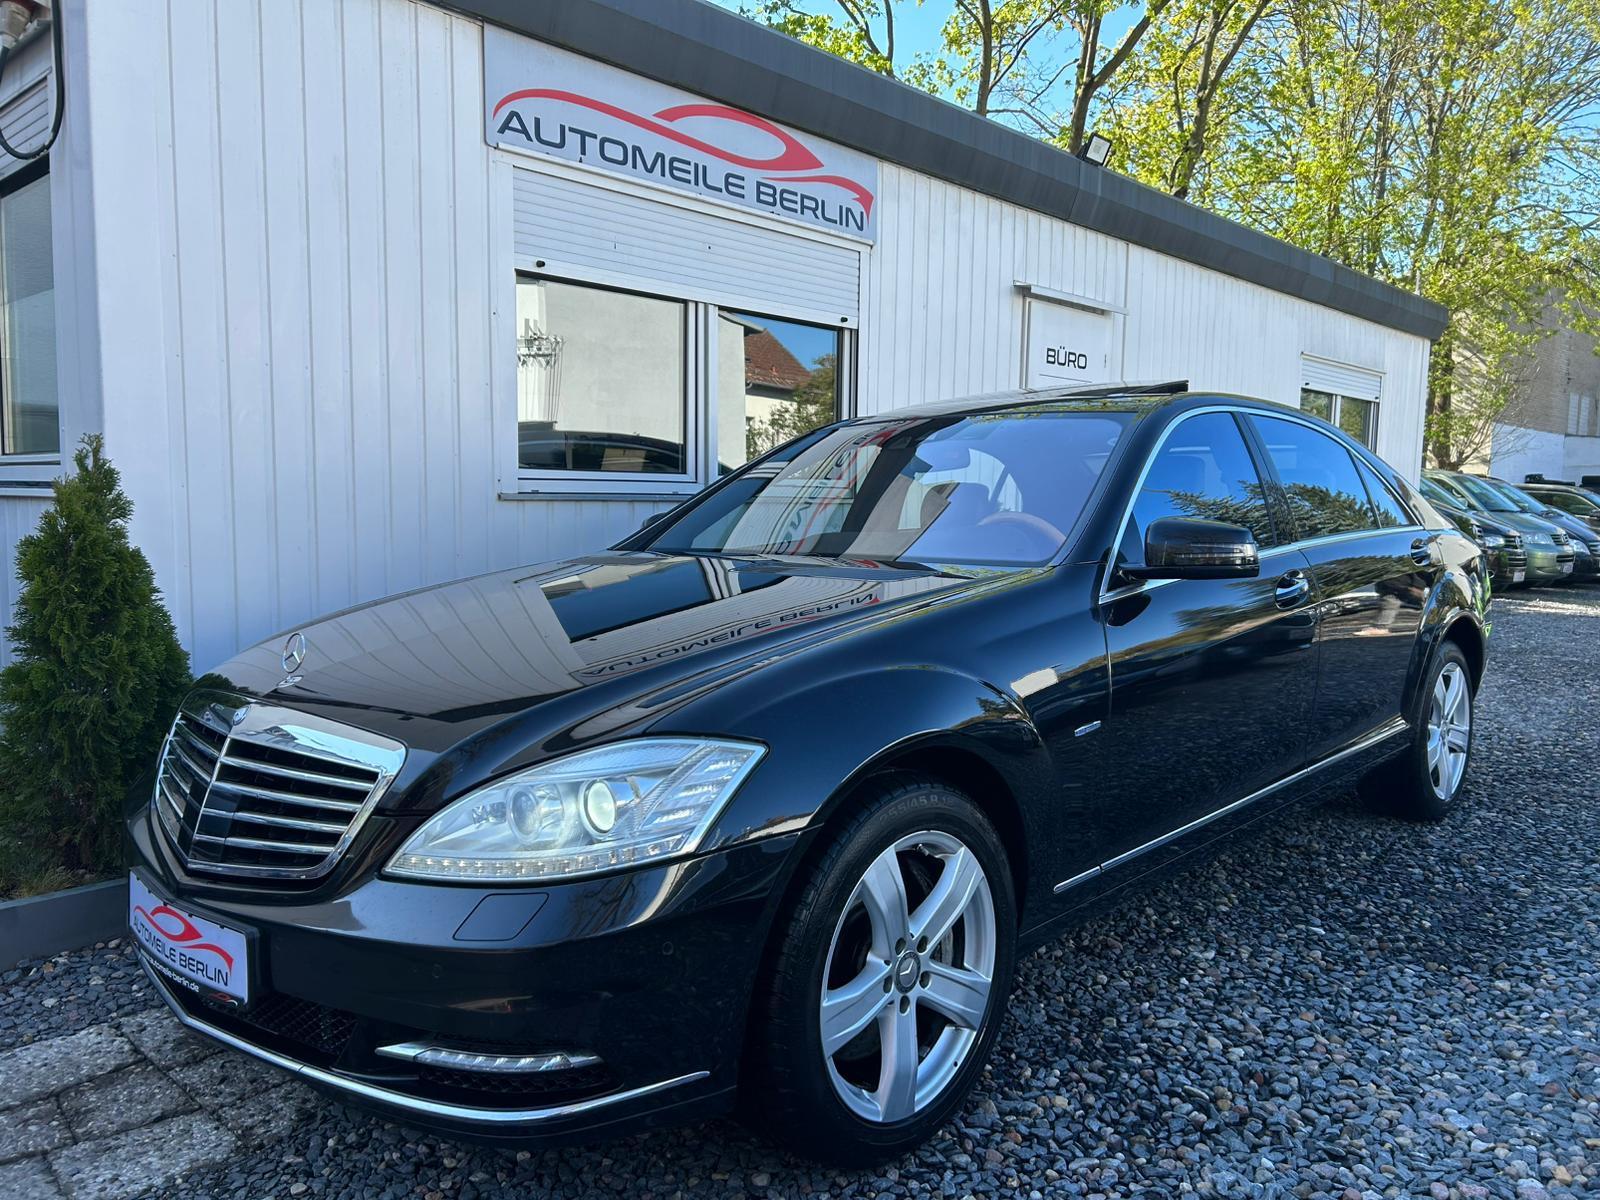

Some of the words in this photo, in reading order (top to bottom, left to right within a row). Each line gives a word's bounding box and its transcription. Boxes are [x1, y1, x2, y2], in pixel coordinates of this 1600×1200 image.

[497, 110, 745, 199] AUTOMEILE
[755, 180, 865, 231] BERLIN
[1046, 345, 1088, 370] BÜRO
[179, 952, 229, 987] BERLIN
